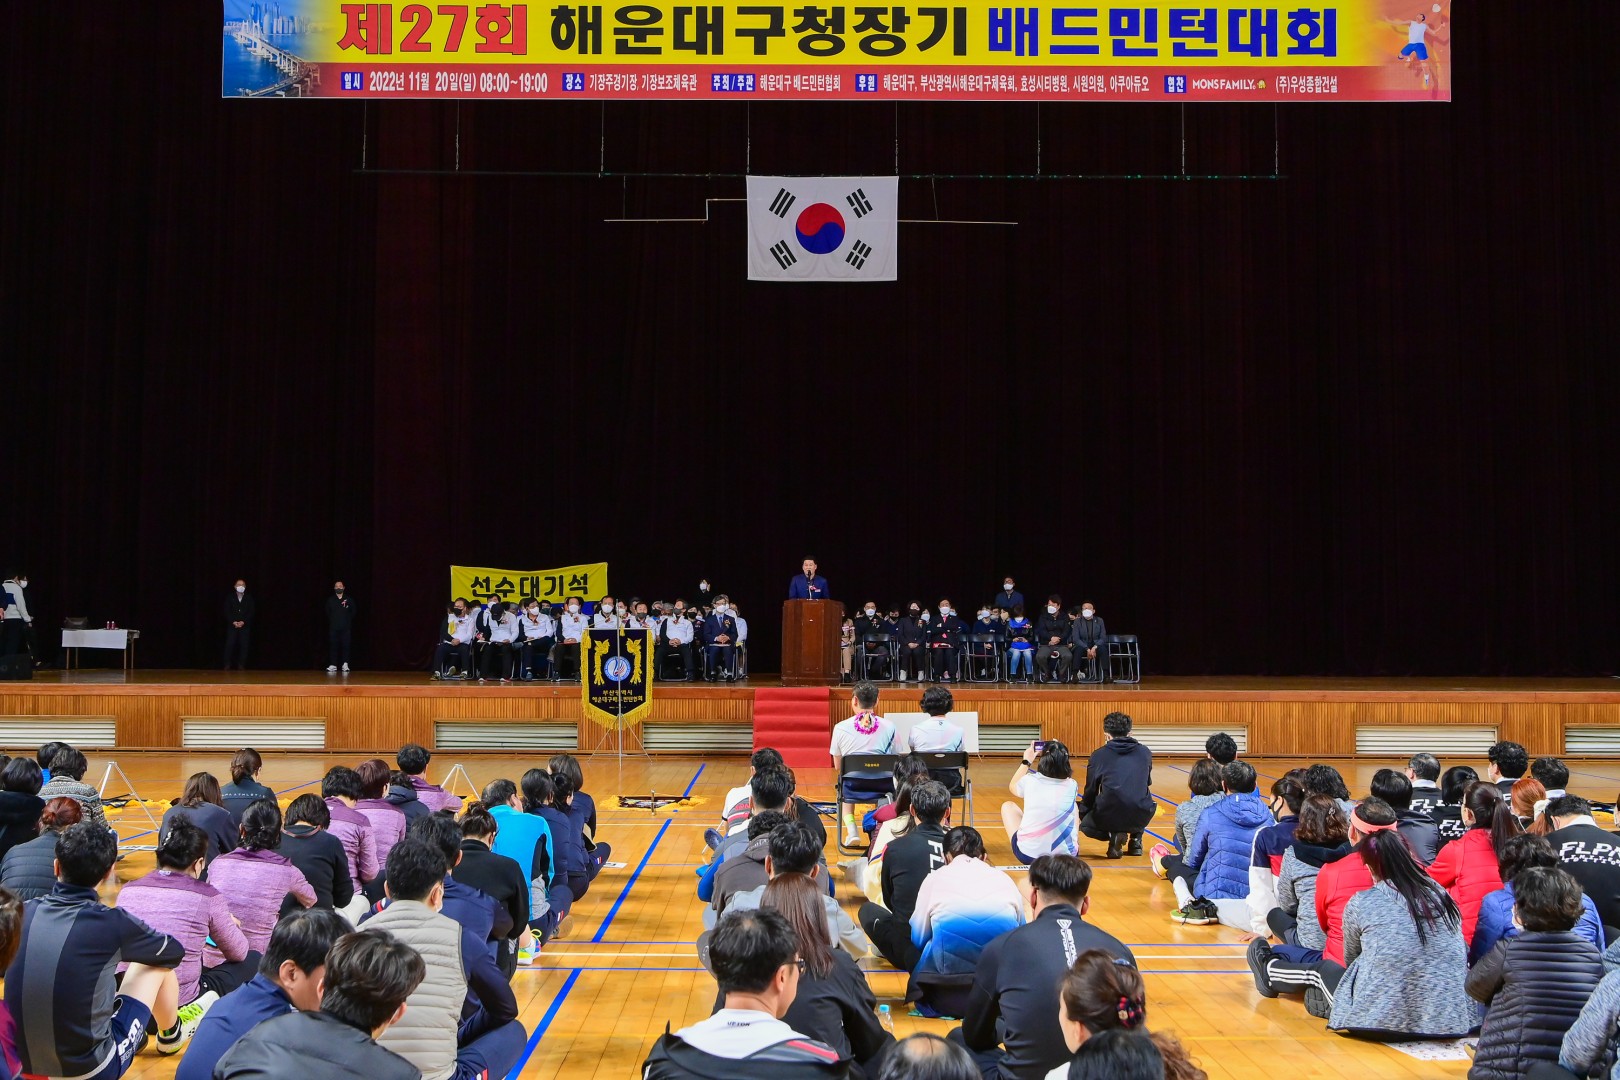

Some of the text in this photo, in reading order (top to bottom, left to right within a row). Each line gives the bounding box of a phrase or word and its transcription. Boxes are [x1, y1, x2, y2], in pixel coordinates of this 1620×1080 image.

[336, 4, 1337, 57] 제27회 해운대구청장기 배드민턴대회
[344, 71, 548, 93] 일시 2022년 11월 20일(일) 08:00~19:00
[565, 73, 582, 90] 장소
[641, 73, 698, 91] 기장보조체육관
[759, 74, 792, 91] 해운대구
[793, 74, 841, 92] 배드민턴협회
[858, 74, 875, 91] 후원
[883, 73, 917, 92] 해운대구,
[1020, 75, 1070, 92] 효성시티병원,
[1109, 75, 1150, 93] 아쿠아듀오
[1167, 76, 1184, 93] 협찬
[1275, 75, 1338, 94] (주)우성종합건설
[471, 573, 589, 598] 선수대기석
